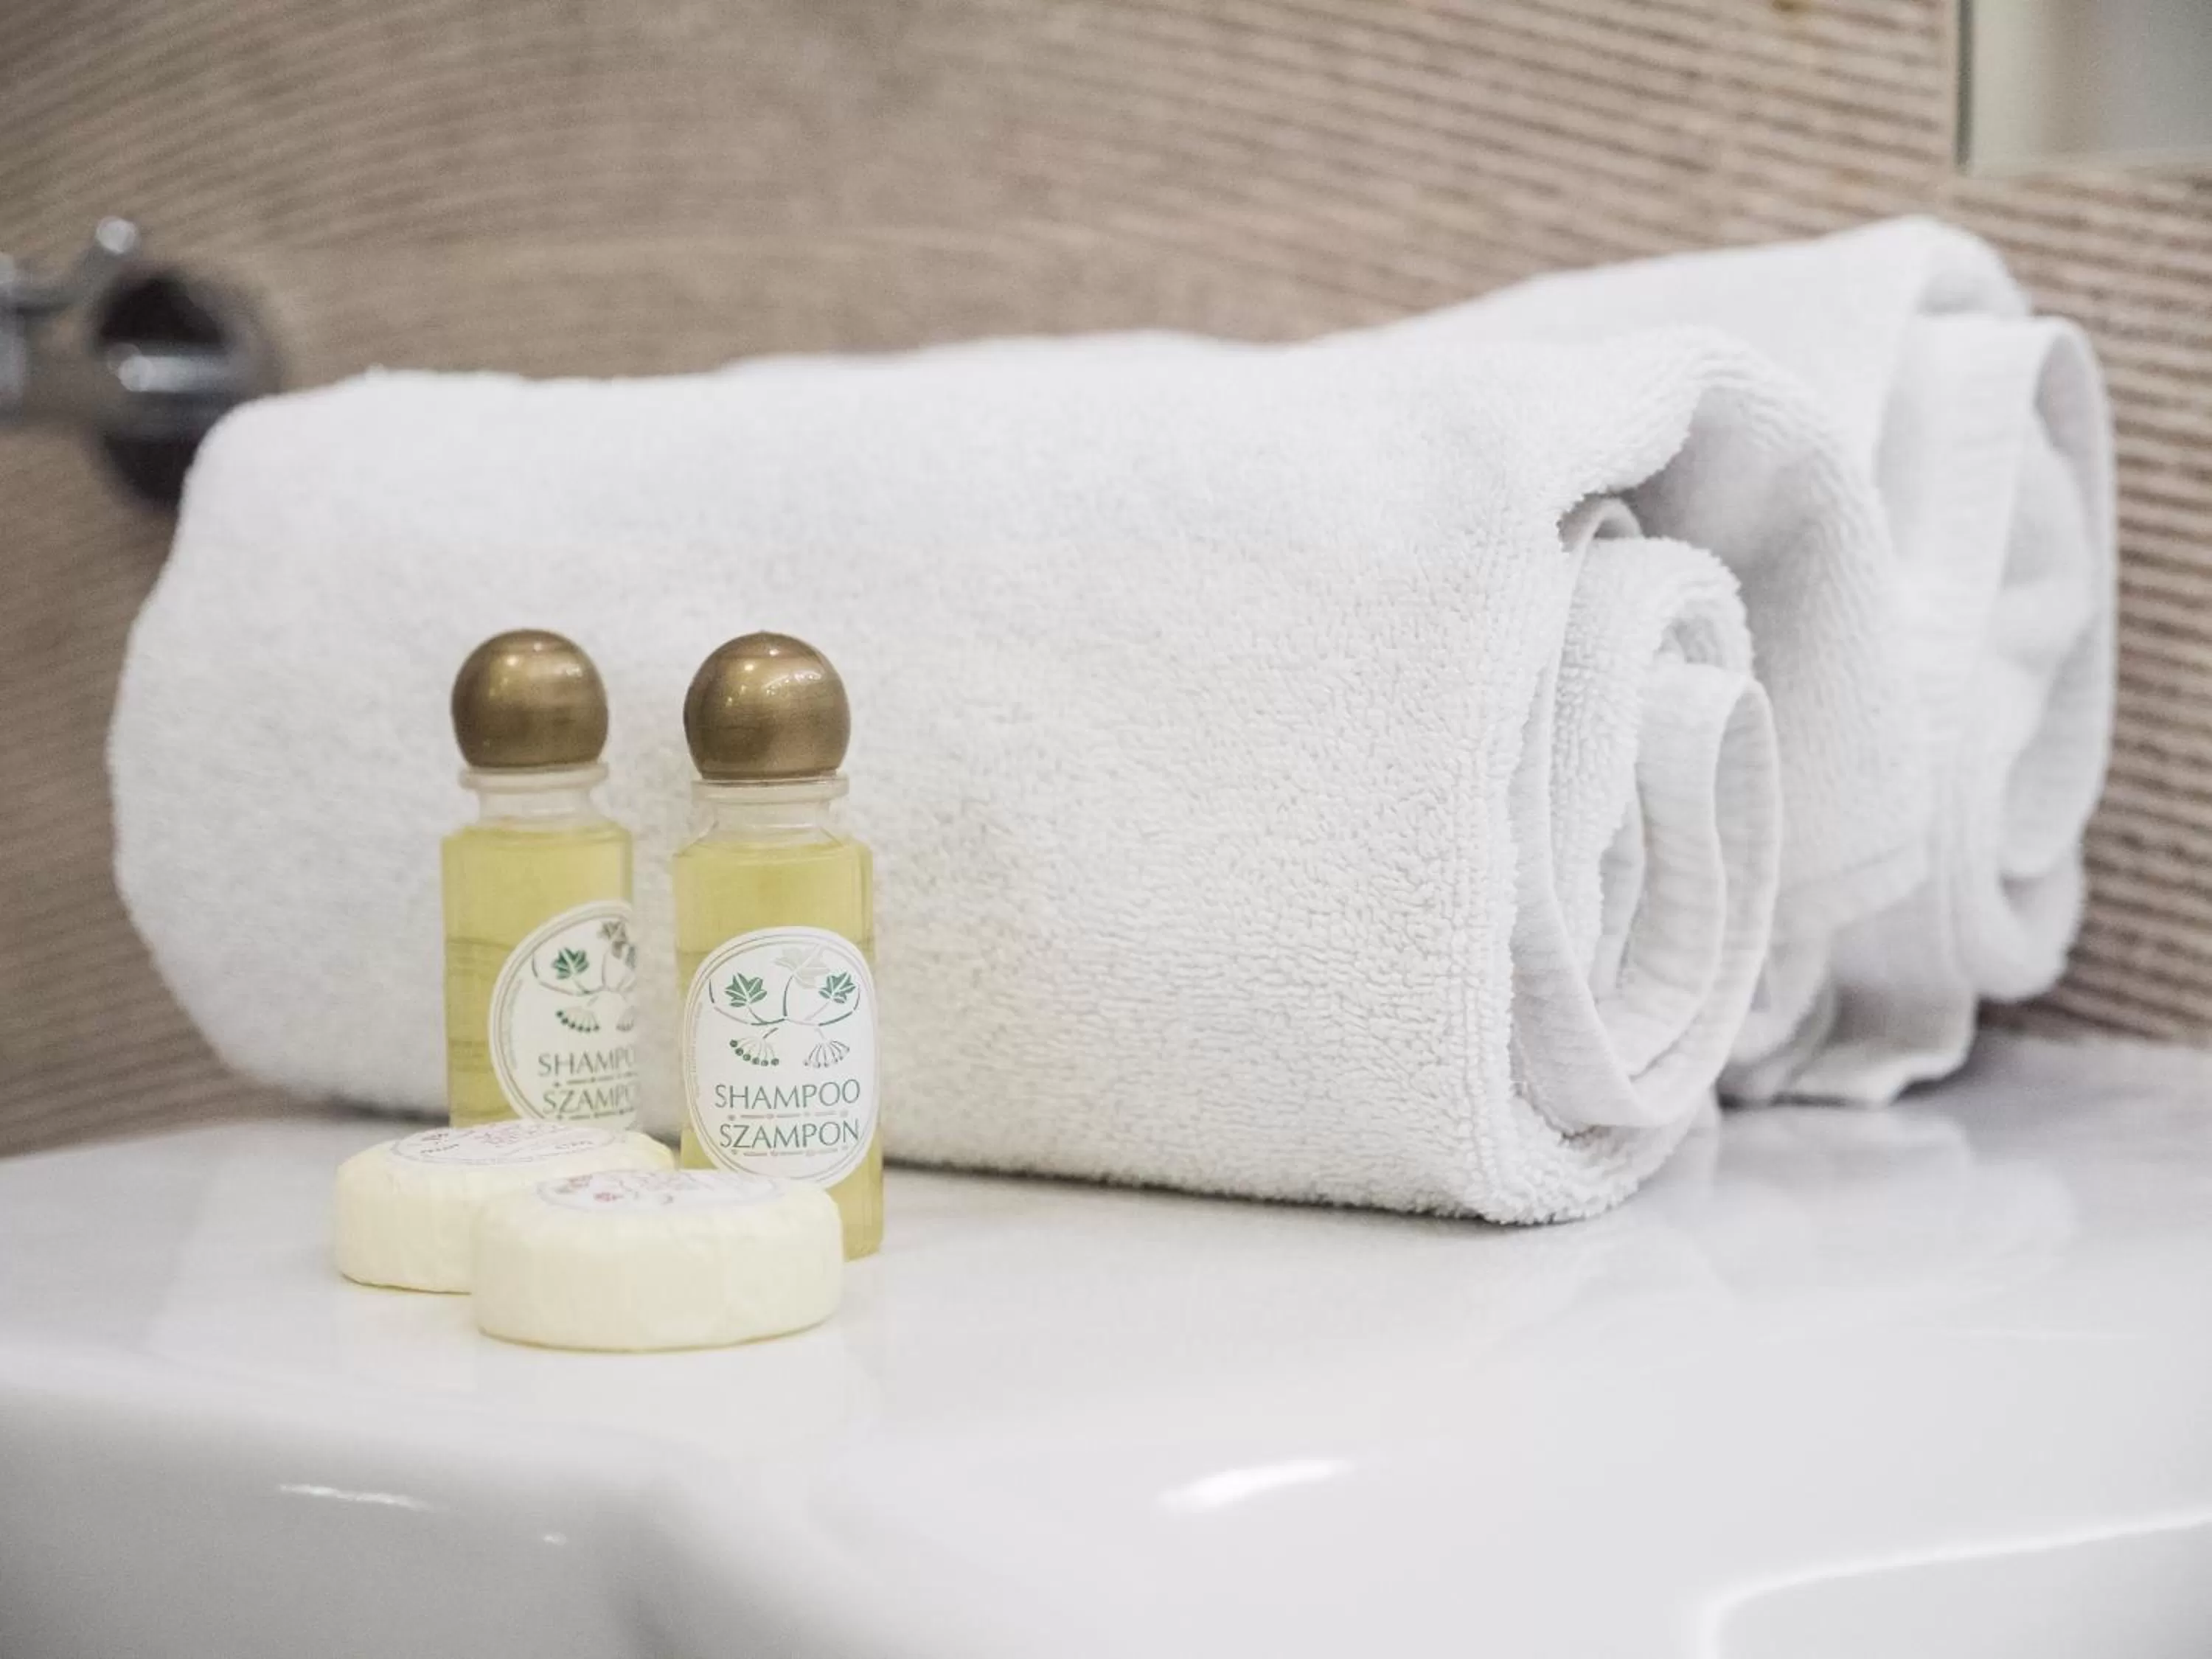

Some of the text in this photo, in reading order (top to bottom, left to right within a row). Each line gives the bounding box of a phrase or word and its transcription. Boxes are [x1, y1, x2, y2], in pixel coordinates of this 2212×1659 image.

[538, 1044, 636, 1077] SHAMPO
[543, 1081, 640, 1114] SZAMPO
[714, 1079, 860, 1109] SHAMPOO
[720, 1118, 859, 1148] SZAMPON
